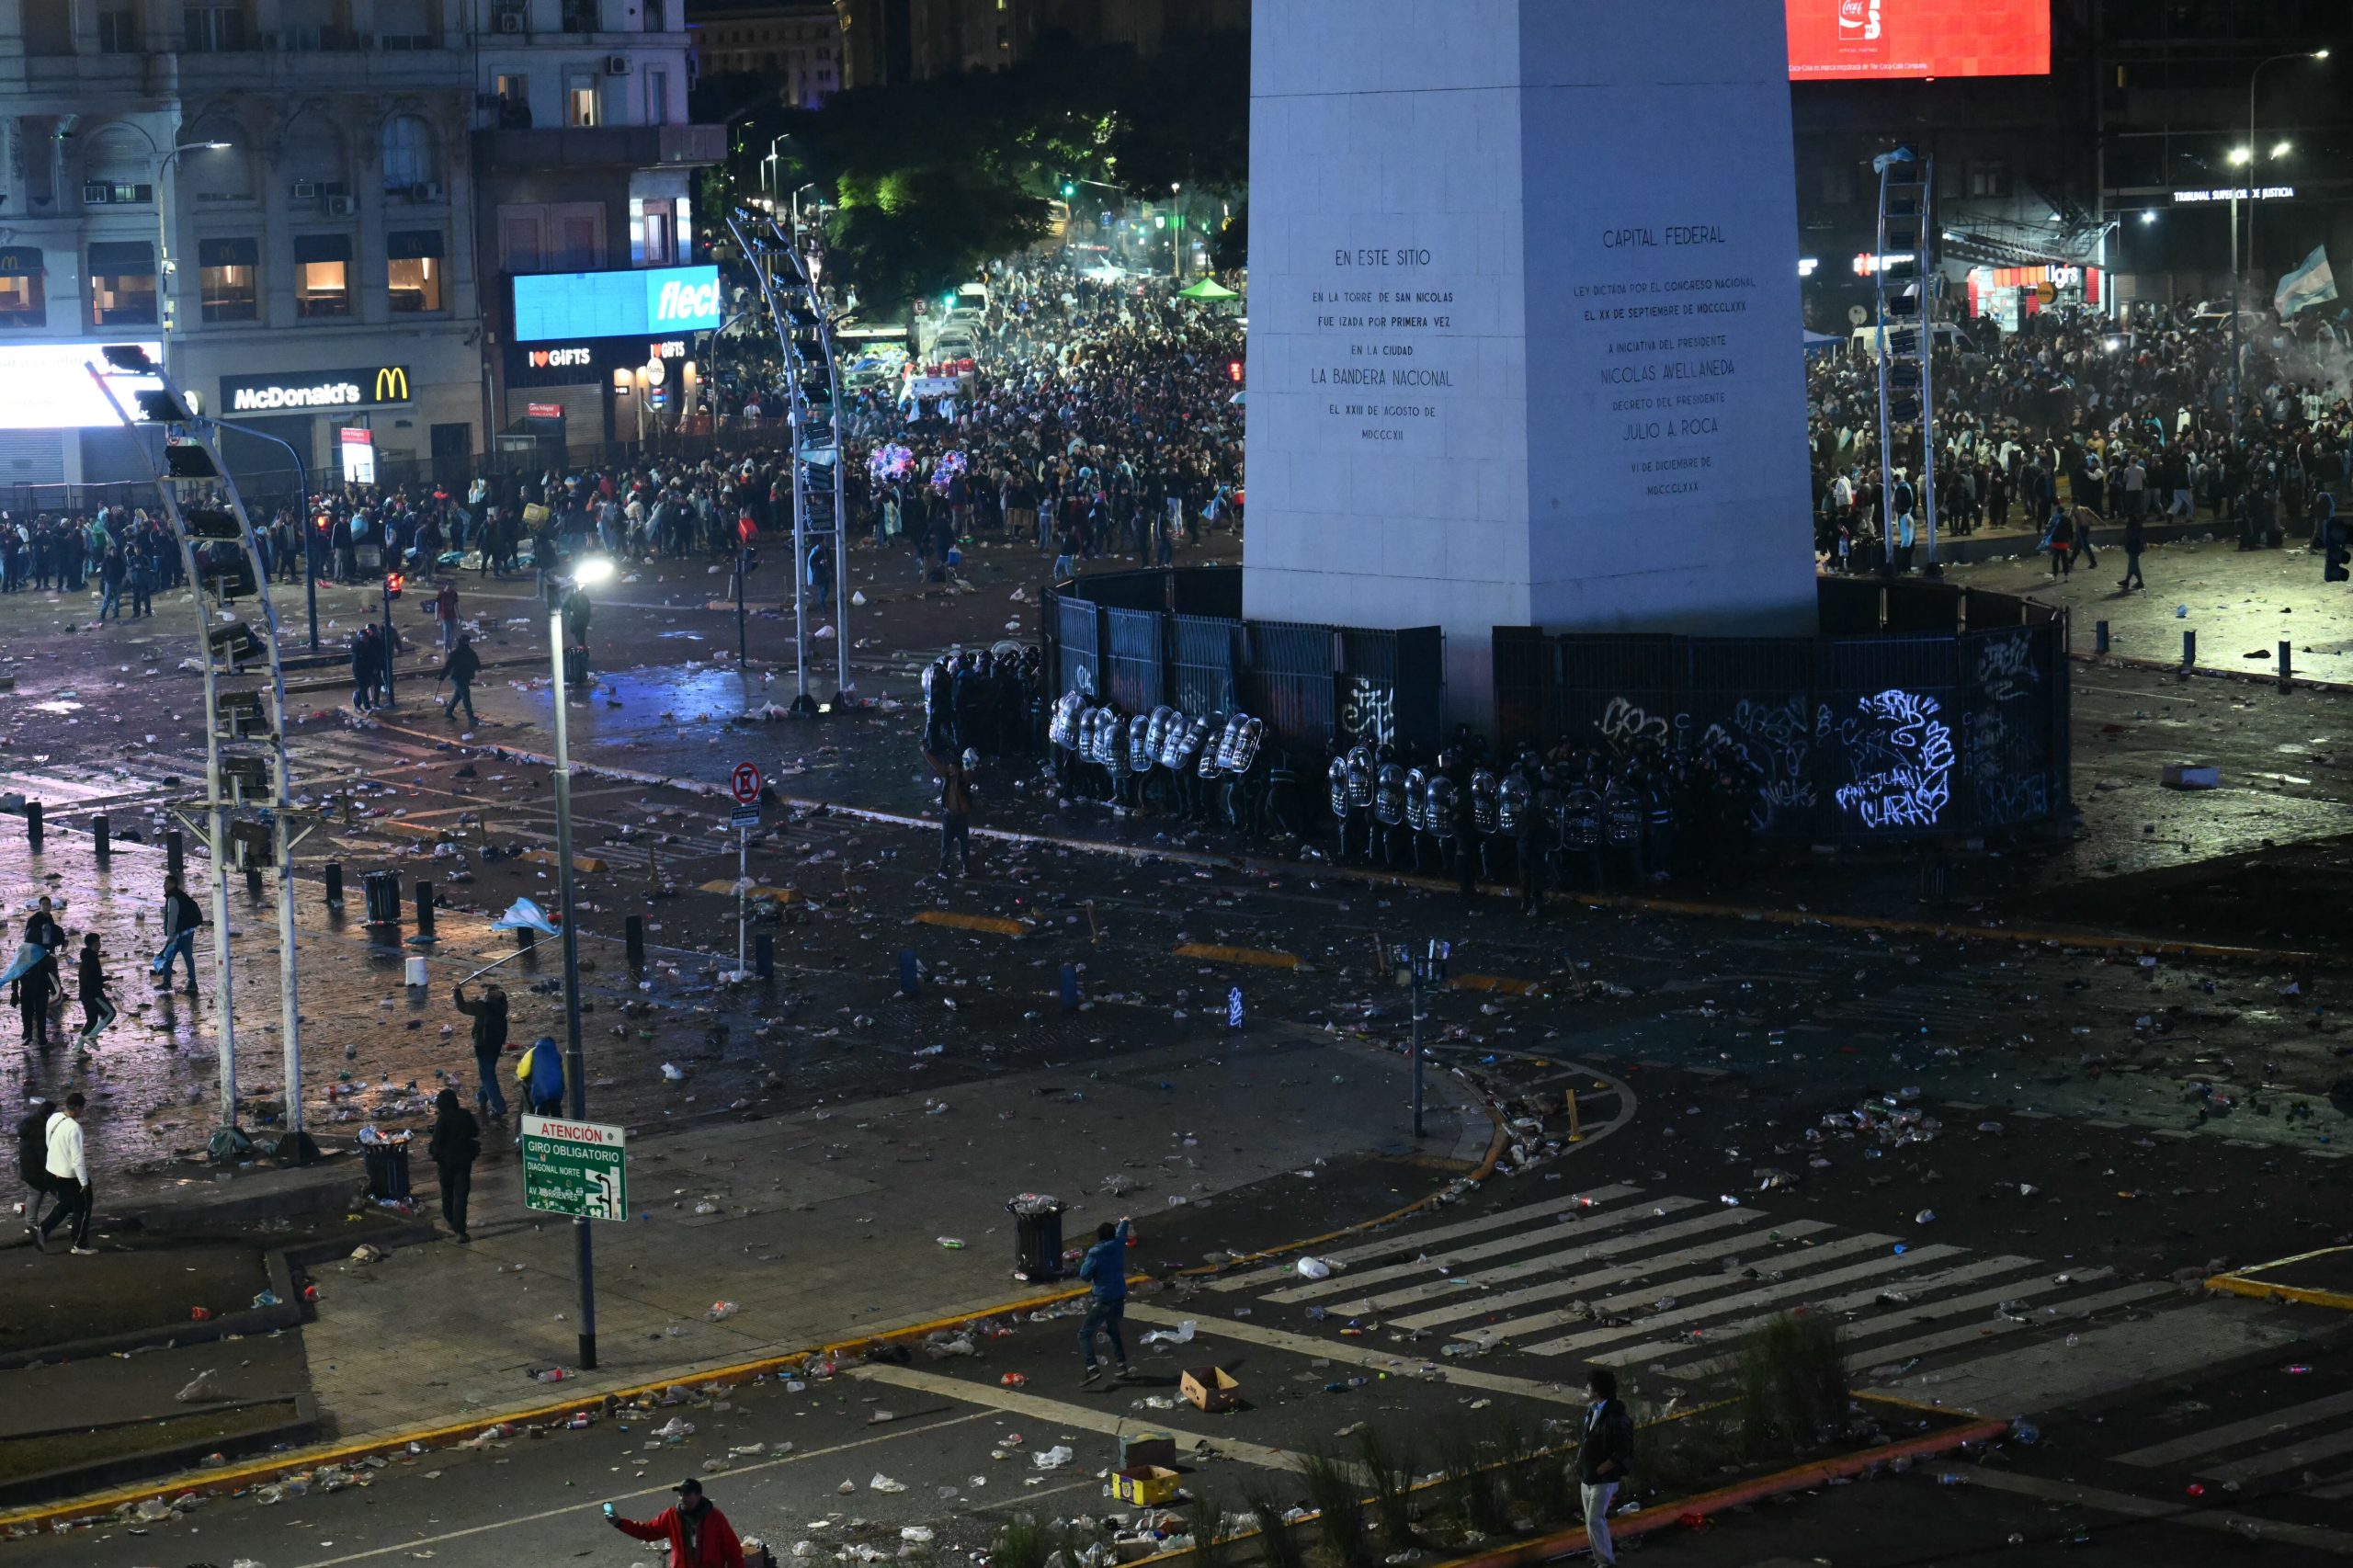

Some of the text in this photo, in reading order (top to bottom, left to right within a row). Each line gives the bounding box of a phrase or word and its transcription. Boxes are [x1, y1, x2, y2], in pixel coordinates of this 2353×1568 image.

[2174, 191, 2211, 202] TRIBUNAL
[2212, 189, 2248, 199] SUPEROR
[2262, 187, 2294, 199] JUSTICIA
[1603, 226, 1725, 248] CAPITAL FEDERAL
[1336, 250, 1430, 266] EN ESTE SITIO
[1574, 278, 1756, 297] LEY DICTADA POR EL CONGRESO NACIONAL
[1313, 292, 1453, 302] EN LA TORRE DE SAN NICOLAS
[1585, 301, 1746, 321] EL XX DE SEPTIEMBRE DE MDCCCLXXX
[1318, 316, 1450, 327] FUE IZADA POR PRIMERA VEZ
[1351, 346, 1414, 356] EN LA CIUDAD
[1608, 335, 1726, 354] A INICIATIVA DEL PRESIDENTE
[1312, 368, 1454, 386] LA BANDERA NACIONAL
[1601, 359, 1735, 384] NICOLAS AVELLANEDA
[234, 382, 360, 410] McDonald's
[1612, 392, 1725, 411] DECRETO DEL PRESIDENTE
[1329, 404, 1436, 417] EL XXIII DE AGOSTO DE
[1362, 429, 1404, 440] MDCCCXII
[1623, 422, 1660, 441] JULIO
[1682, 417, 1719, 436] ROCA
[1632, 457, 1711, 472] VI DE DICIEMBRE DE
[1647, 482, 1699, 495] MDCCCLXXX
[541, 1122, 603, 1142] ATENCIÓN
[528, 1141, 620, 1163] GIRO OBLIGATORIO
[528, 1162, 581, 1177] DIAGONAL NORTE
[529, 1187, 539, 1195] AV.
